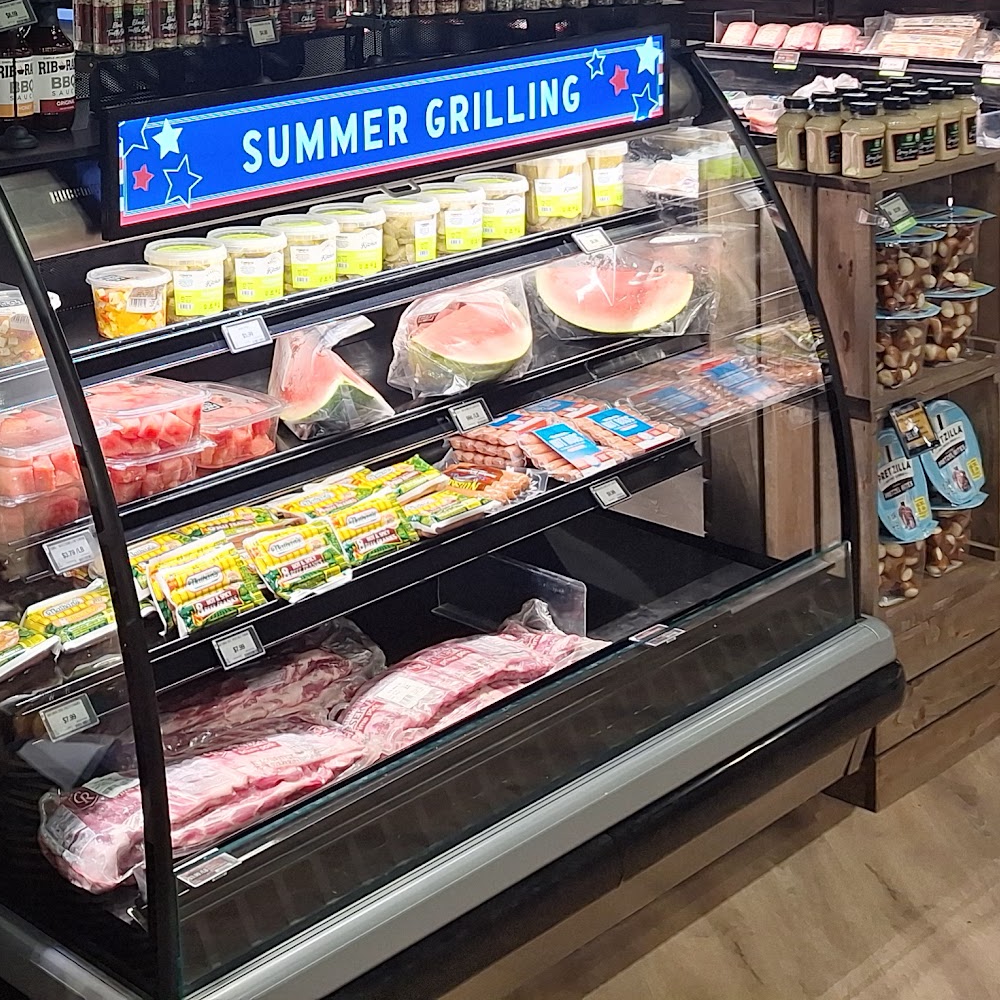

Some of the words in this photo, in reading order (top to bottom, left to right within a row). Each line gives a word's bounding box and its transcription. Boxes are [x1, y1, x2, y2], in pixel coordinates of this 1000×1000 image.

[37, 60, 58, 75] RIB
[241, 104, 409, 174] SUMMER
[424, 74, 581, 140] GRILLING
[938, 424, 963, 444] TZILLA
